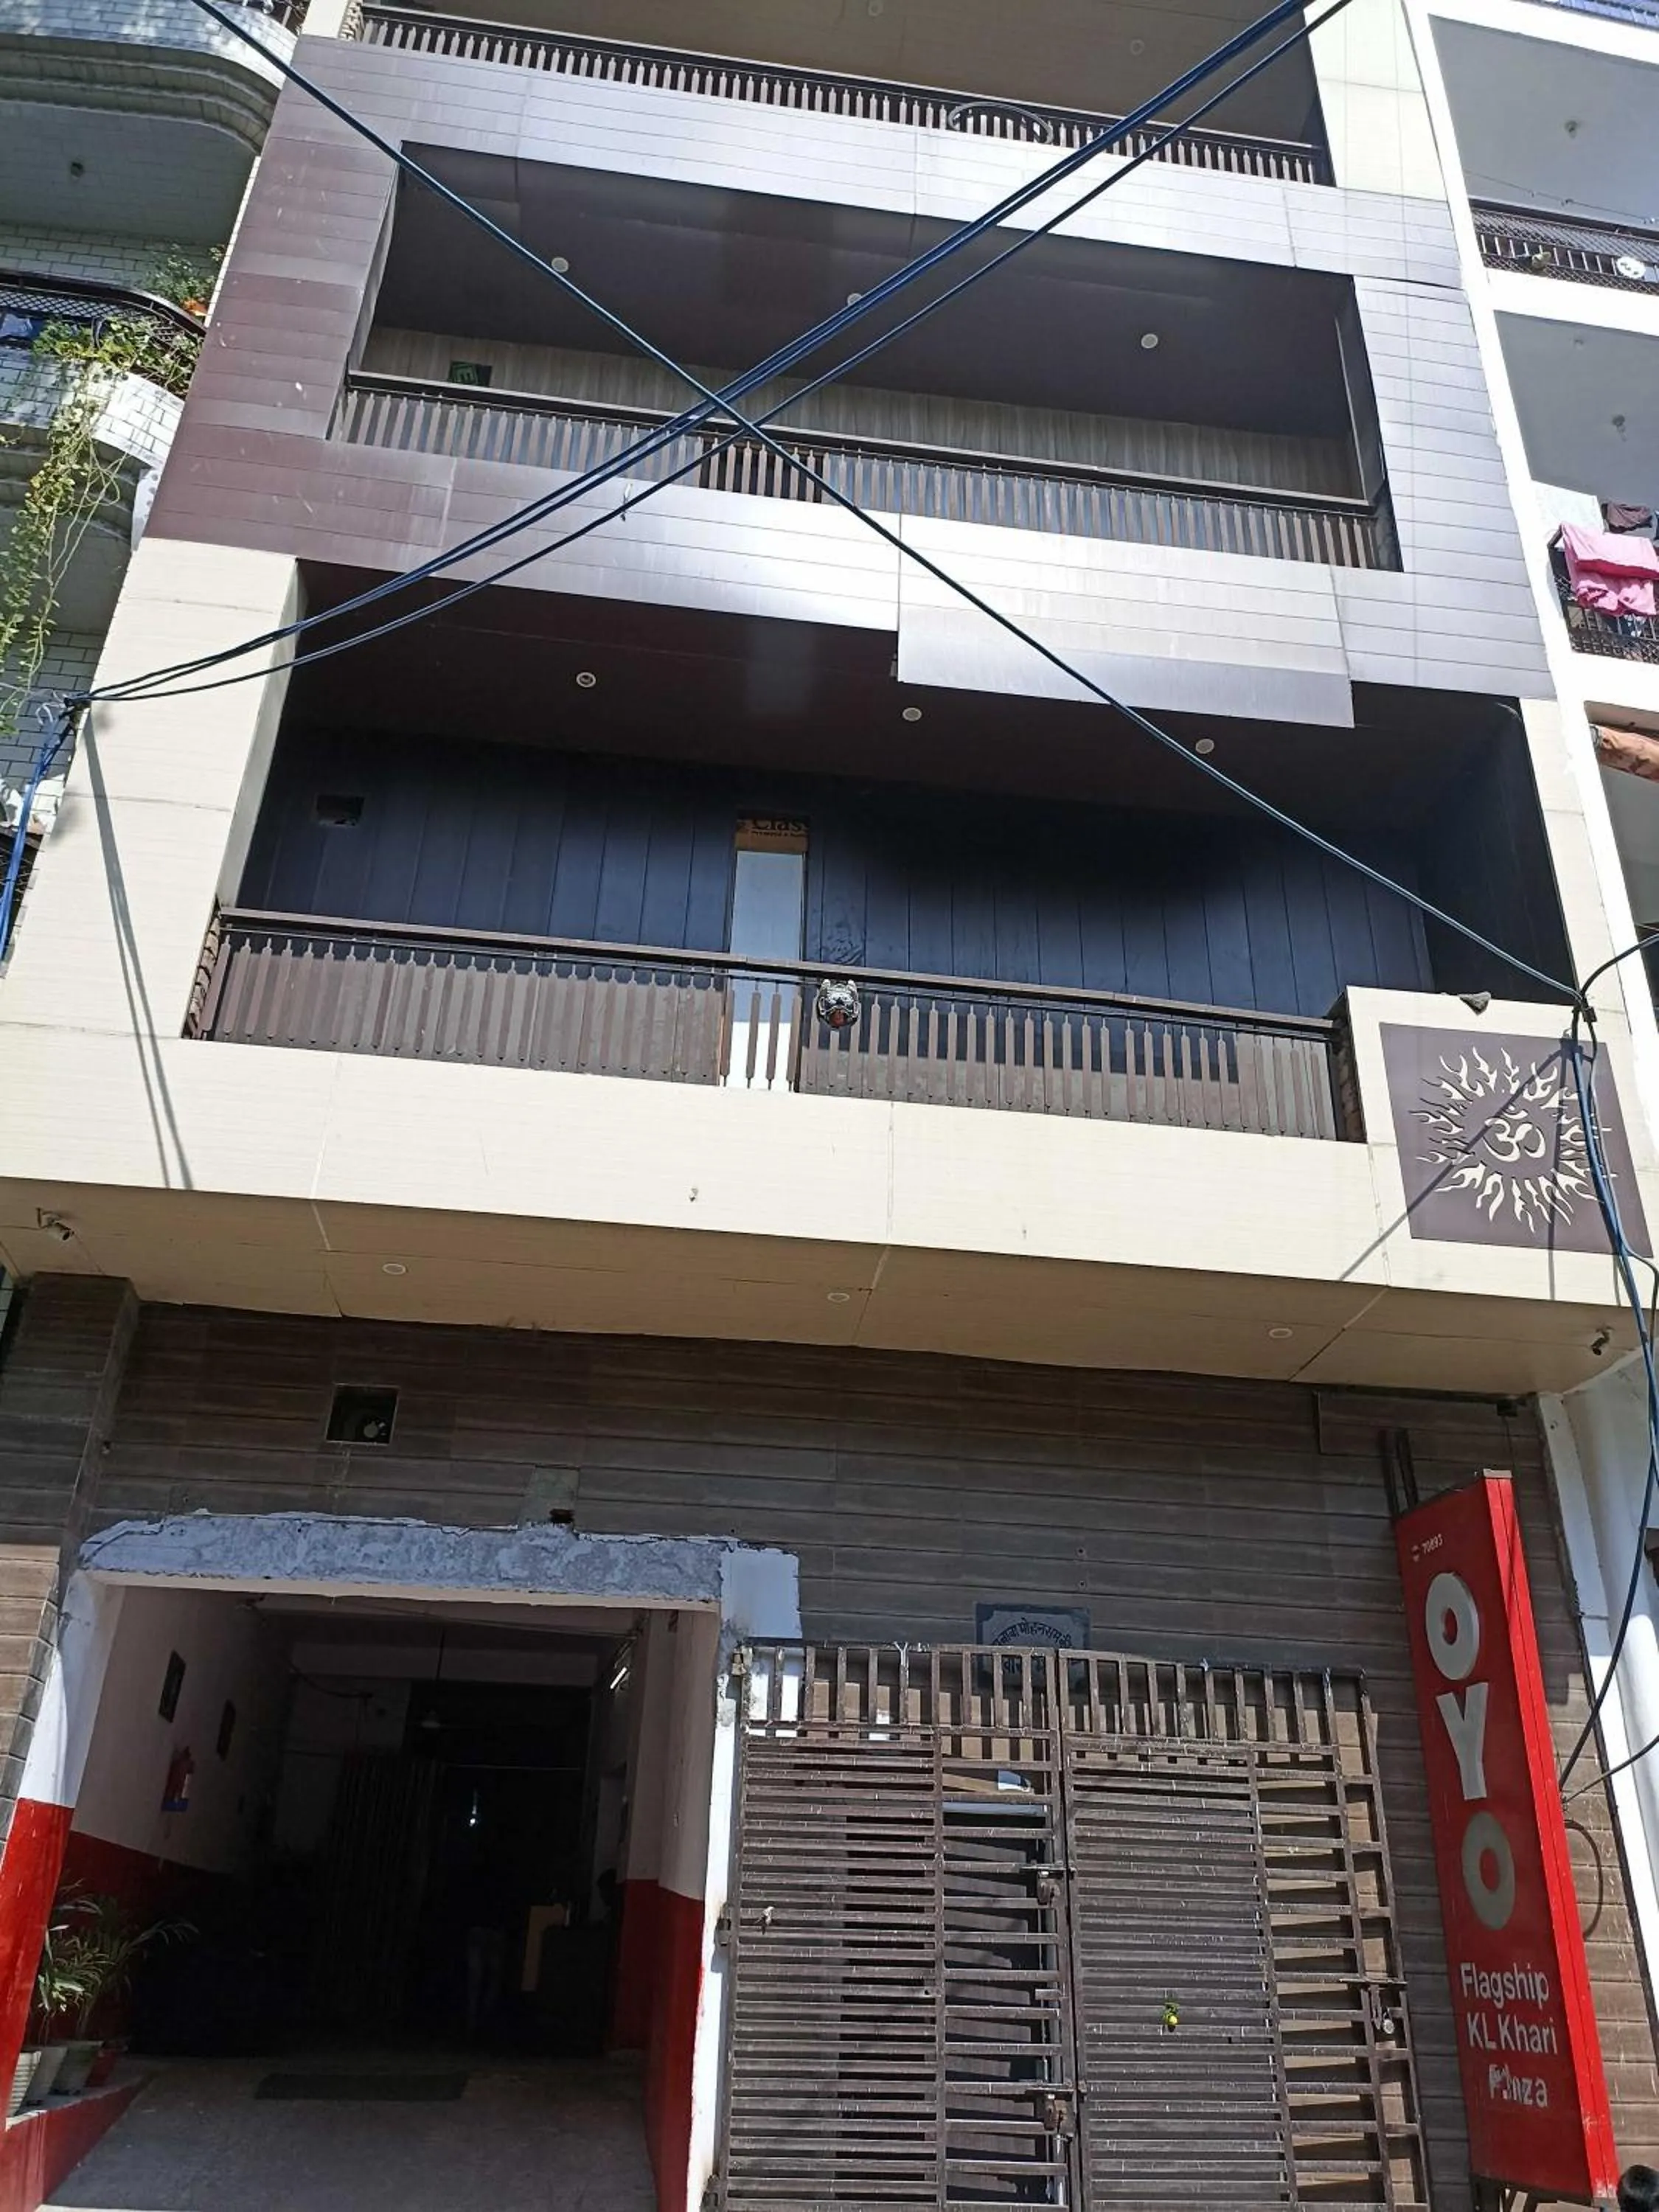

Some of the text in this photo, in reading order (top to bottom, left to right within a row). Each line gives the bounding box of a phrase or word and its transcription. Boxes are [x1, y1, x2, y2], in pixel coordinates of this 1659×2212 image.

[1425, 1572, 1516, 1930] OYO
[1460, 1961, 1549, 2010] Flagship
[1467, 2011, 1558, 2055] KL Khari
